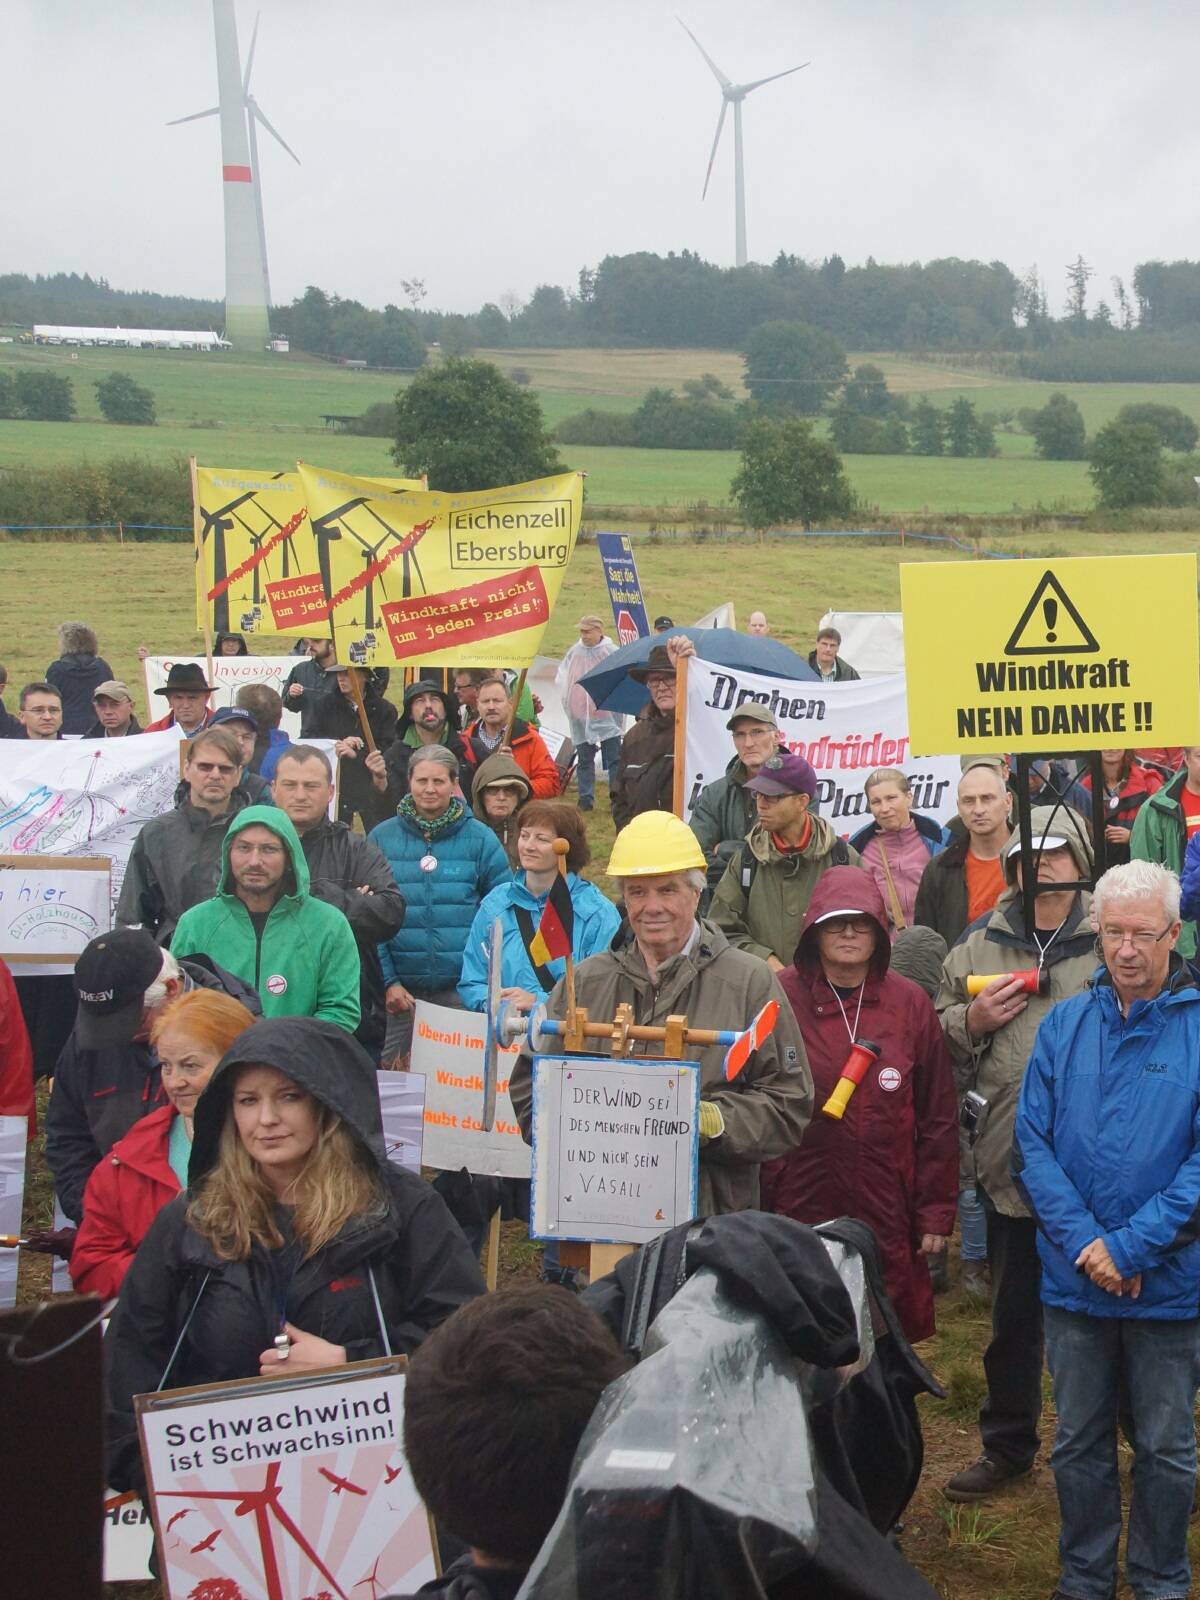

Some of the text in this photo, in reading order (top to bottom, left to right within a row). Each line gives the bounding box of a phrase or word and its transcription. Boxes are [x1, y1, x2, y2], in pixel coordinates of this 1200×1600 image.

[212, 477, 295, 492] Aufgewacht
[455, 507, 566, 530] Eichenzell
[456, 541, 568, 564] Ebersburg
[608, 566, 635, 585] Sagt die
[387, 580, 537, 625] Windkraft nicht
[610, 588, 642, 605] Wahrheit!
[276, 608, 294, 618] um
[395, 598, 539, 644] um jeden Preis!
[214, 662, 282, 677] Invasion
[976, 658, 1130, 693] Windkraft
[957, 701, 1153, 738] NEIN DANKE !!
[18, 878, 67, 902] hier
[418, 1021, 461, 1046] Überall
[465, 1034, 485, 1049] im
[436, 1070, 509, 1093] Windkaf
[573, 1087, 601, 1104] DER
[569, 1118, 590, 1132] DES
[644, 1118, 690, 1136] FREUND
[567, 1150, 596, 1164] UND
[579, 1173, 642, 1198] VASALL
[166, 1391, 391, 1447] Schwachwind
[169, 1419, 396, 1472] ist Schwachsinn!
